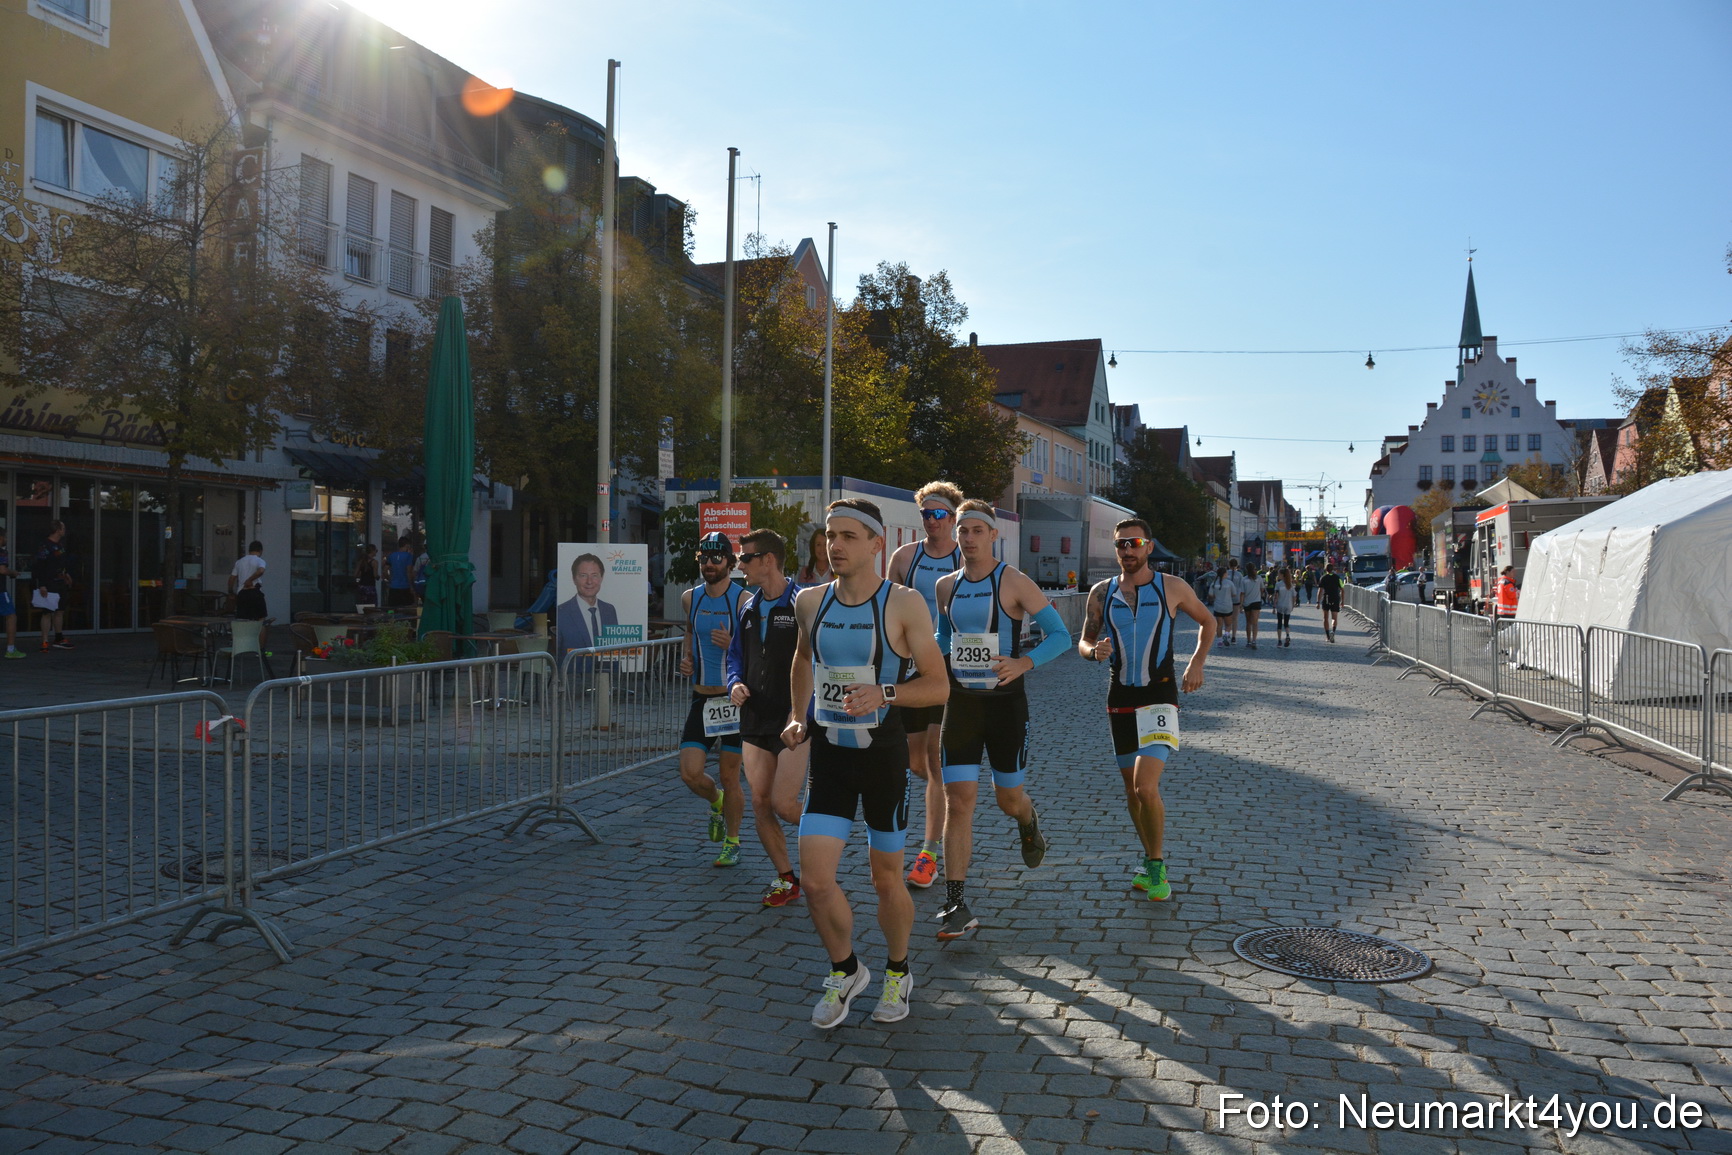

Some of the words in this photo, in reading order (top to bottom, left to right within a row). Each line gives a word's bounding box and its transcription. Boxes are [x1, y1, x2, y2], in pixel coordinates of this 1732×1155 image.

[704, 508, 747, 516] Abschluss
[704, 522, 748, 530] Ausschluss!
[702, 542, 724, 551] KULT
[605, 627, 640, 635] THOMAS
[956, 647, 991, 662] 2393
[708, 705, 737, 720] 2157
[833, 713, 856, 723] Daniel
[1157, 715, 1167, 727] 8
